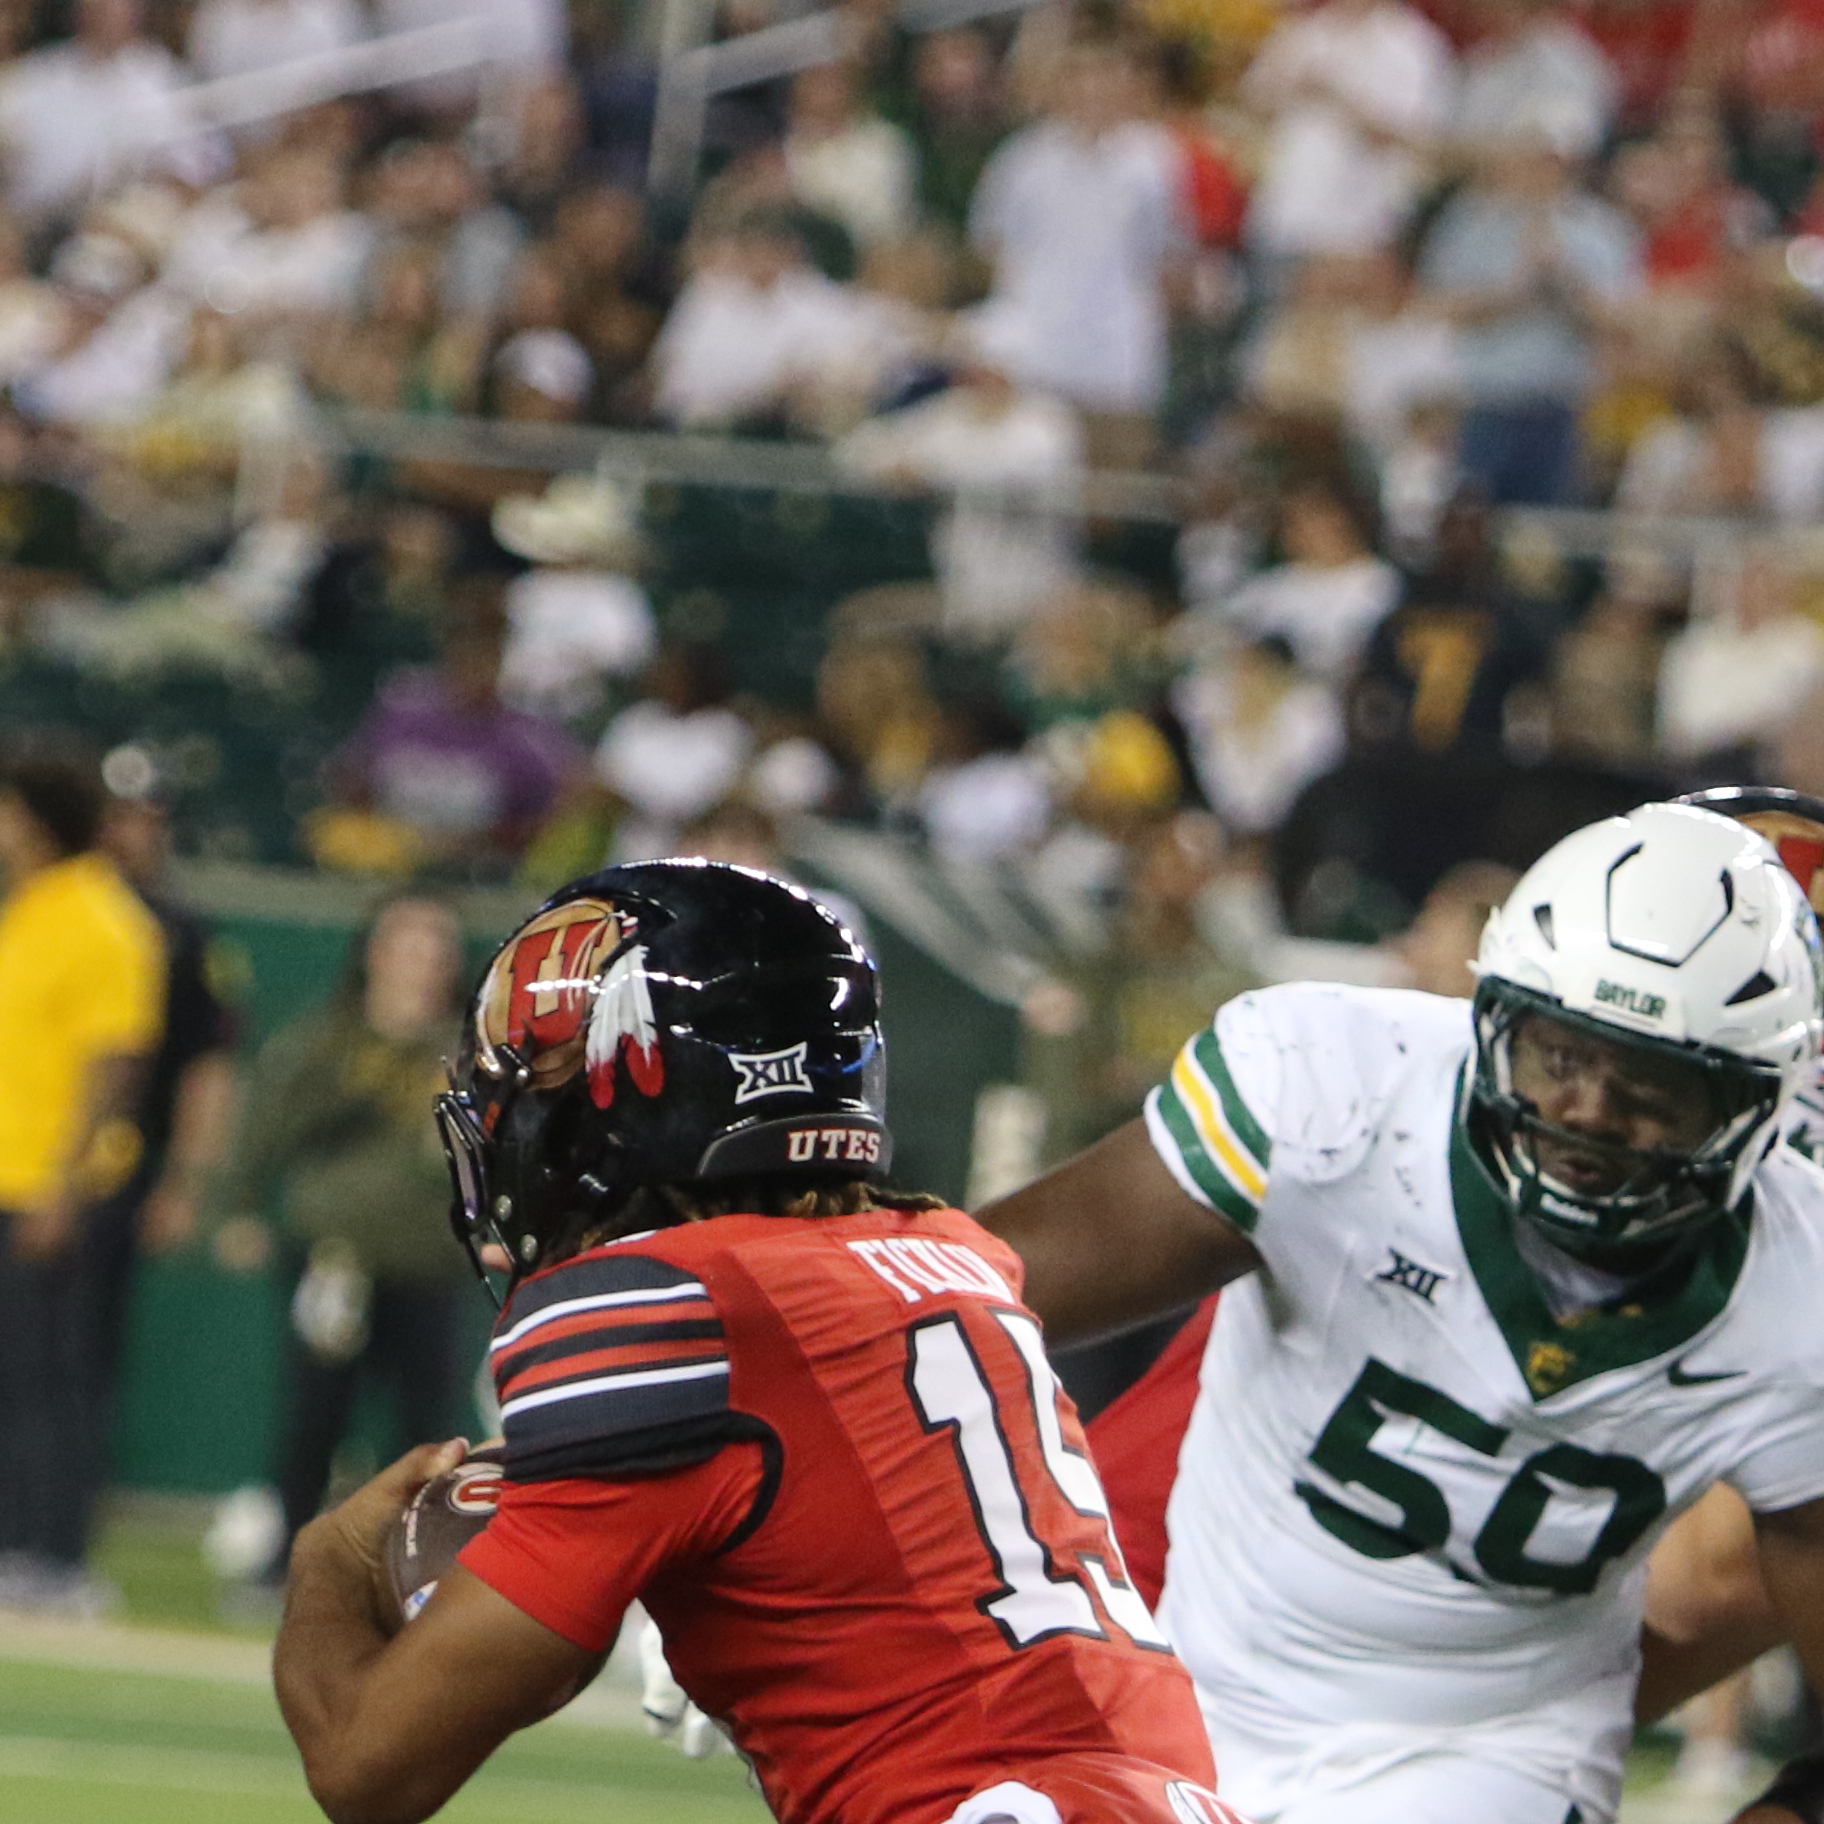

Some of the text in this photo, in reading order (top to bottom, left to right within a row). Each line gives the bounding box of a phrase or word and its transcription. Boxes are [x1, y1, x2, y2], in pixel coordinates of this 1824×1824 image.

[1594, 978, 1666, 1020] BAYLOR
[788, 1129, 882, 1165] UTES
[1295, 1356, 1668, 1594] 50
